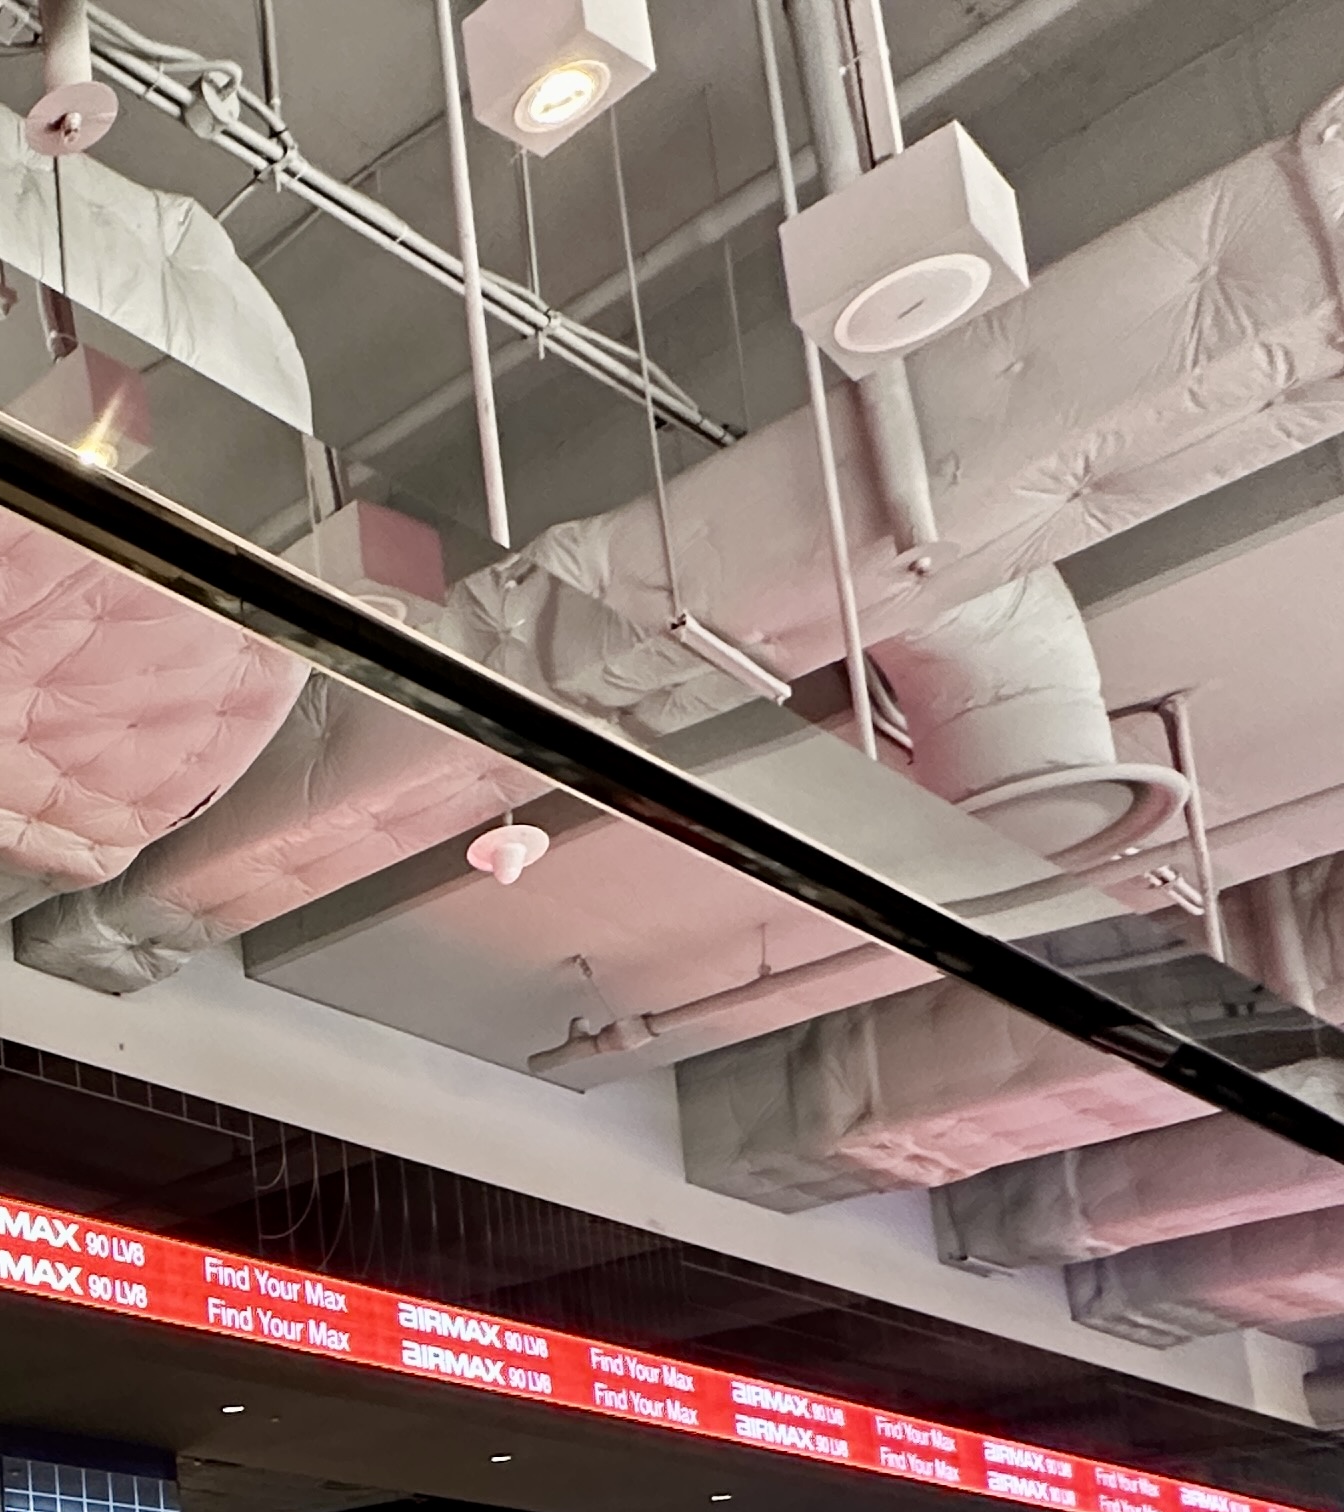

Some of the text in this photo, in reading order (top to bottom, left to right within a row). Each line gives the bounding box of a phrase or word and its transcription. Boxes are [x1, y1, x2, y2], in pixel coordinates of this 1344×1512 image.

[85, 1231, 110, 1259] 90
[112, 1237, 145, 1267] LV8
[88, 1274, 114, 1301] 90
[114, 1279, 148, 1309] LV8
[204, 1256, 348, 1313] Find Your Max
[207, 1296, 351, 1352] Find Your Max
[503, 1330, 523, 1353] 90
[523, 1334, 549, 1359] LV8
[508, 1366, 527, 1390] 90
[527, 1370, 552, 1395] LV8
[590, 1347, 695, 1392] Find Your Max
[594, 1381, 700, 1426] Find Your Max
